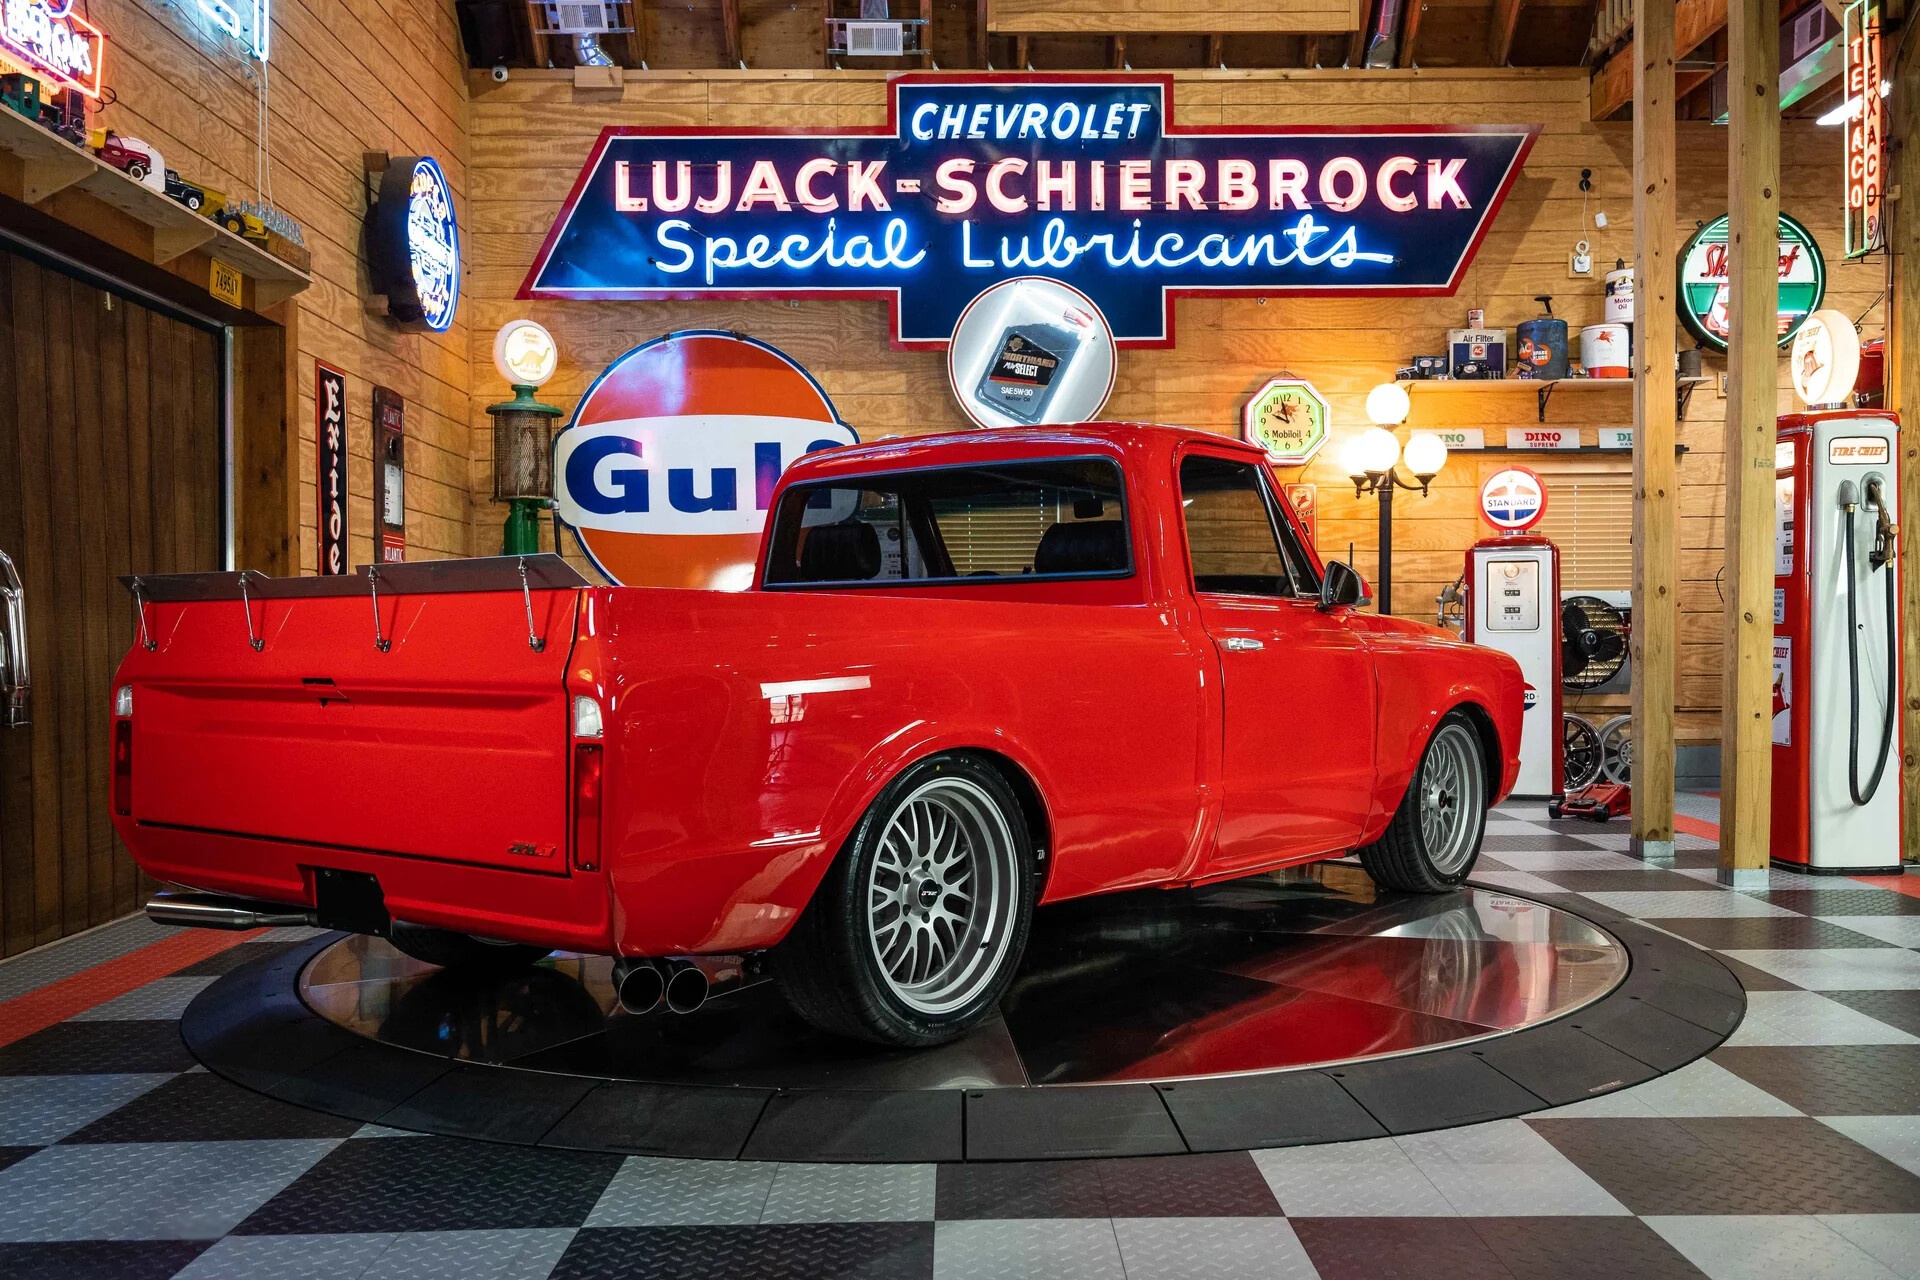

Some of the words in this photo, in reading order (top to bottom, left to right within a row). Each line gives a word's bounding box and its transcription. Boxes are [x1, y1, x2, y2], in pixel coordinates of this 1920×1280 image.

[911, 101, 1151, 140] CHEVROLET
[1850, 37, 1864, 209] TEACO
[655, 217, 926, 284] Special
[963, 213, 1395, 269] Lubricants
[1462, 334, 1473, 342] Air
[1475, 334, 1495, 342] Filter
[1000, 386, 1014, 395] SAE
[1271, 429, 1302, 439] Mobiloil
[1524, 432, 1562, 442] DINO
[1616, 433, 1632, 442] DI
[323, 379, 342, 575] Exide
[1488, 499, 1536, 507] STANDARD
